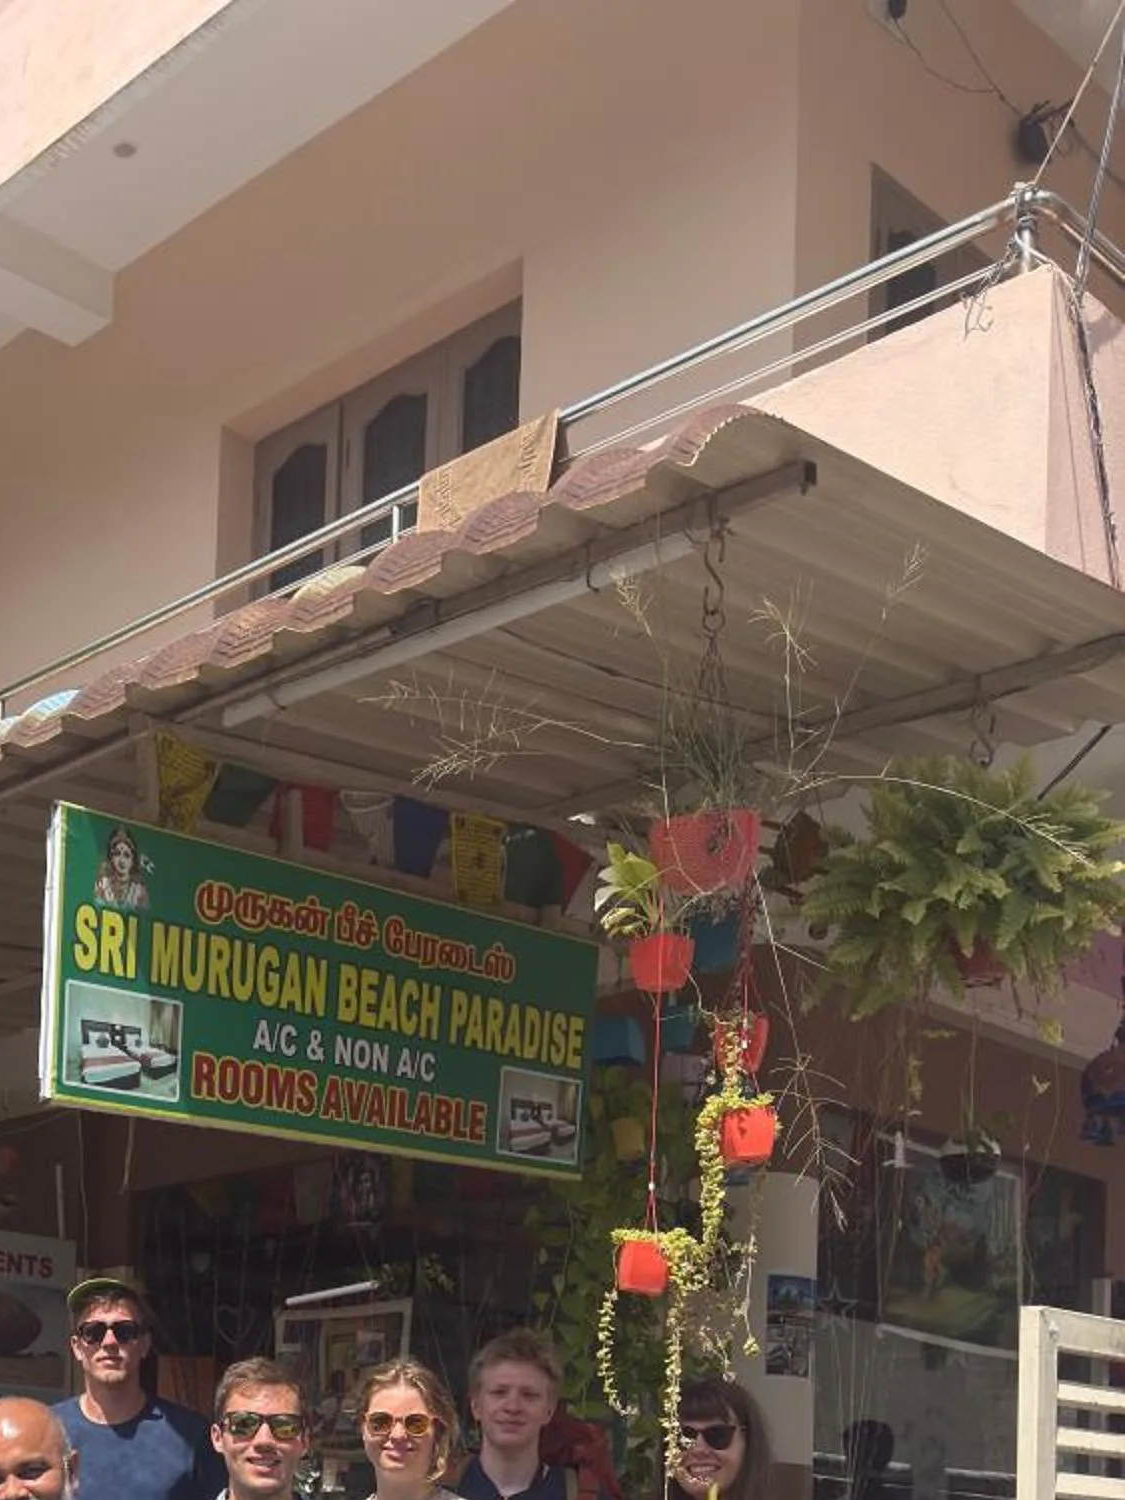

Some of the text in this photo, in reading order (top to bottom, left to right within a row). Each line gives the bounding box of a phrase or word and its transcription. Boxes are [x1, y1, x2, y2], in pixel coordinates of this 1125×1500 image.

[195, 879, 331, 939] முருகன்
[335, 901, 379, 949] பீச்
[74, 904, 585, 1069] SRI MURUGAN BEACH PARADISE
[253, 1019, 437, 1082] A/C & NON A/C
[191, 1051, 487, 1145] ROOMS AVAILABLE
